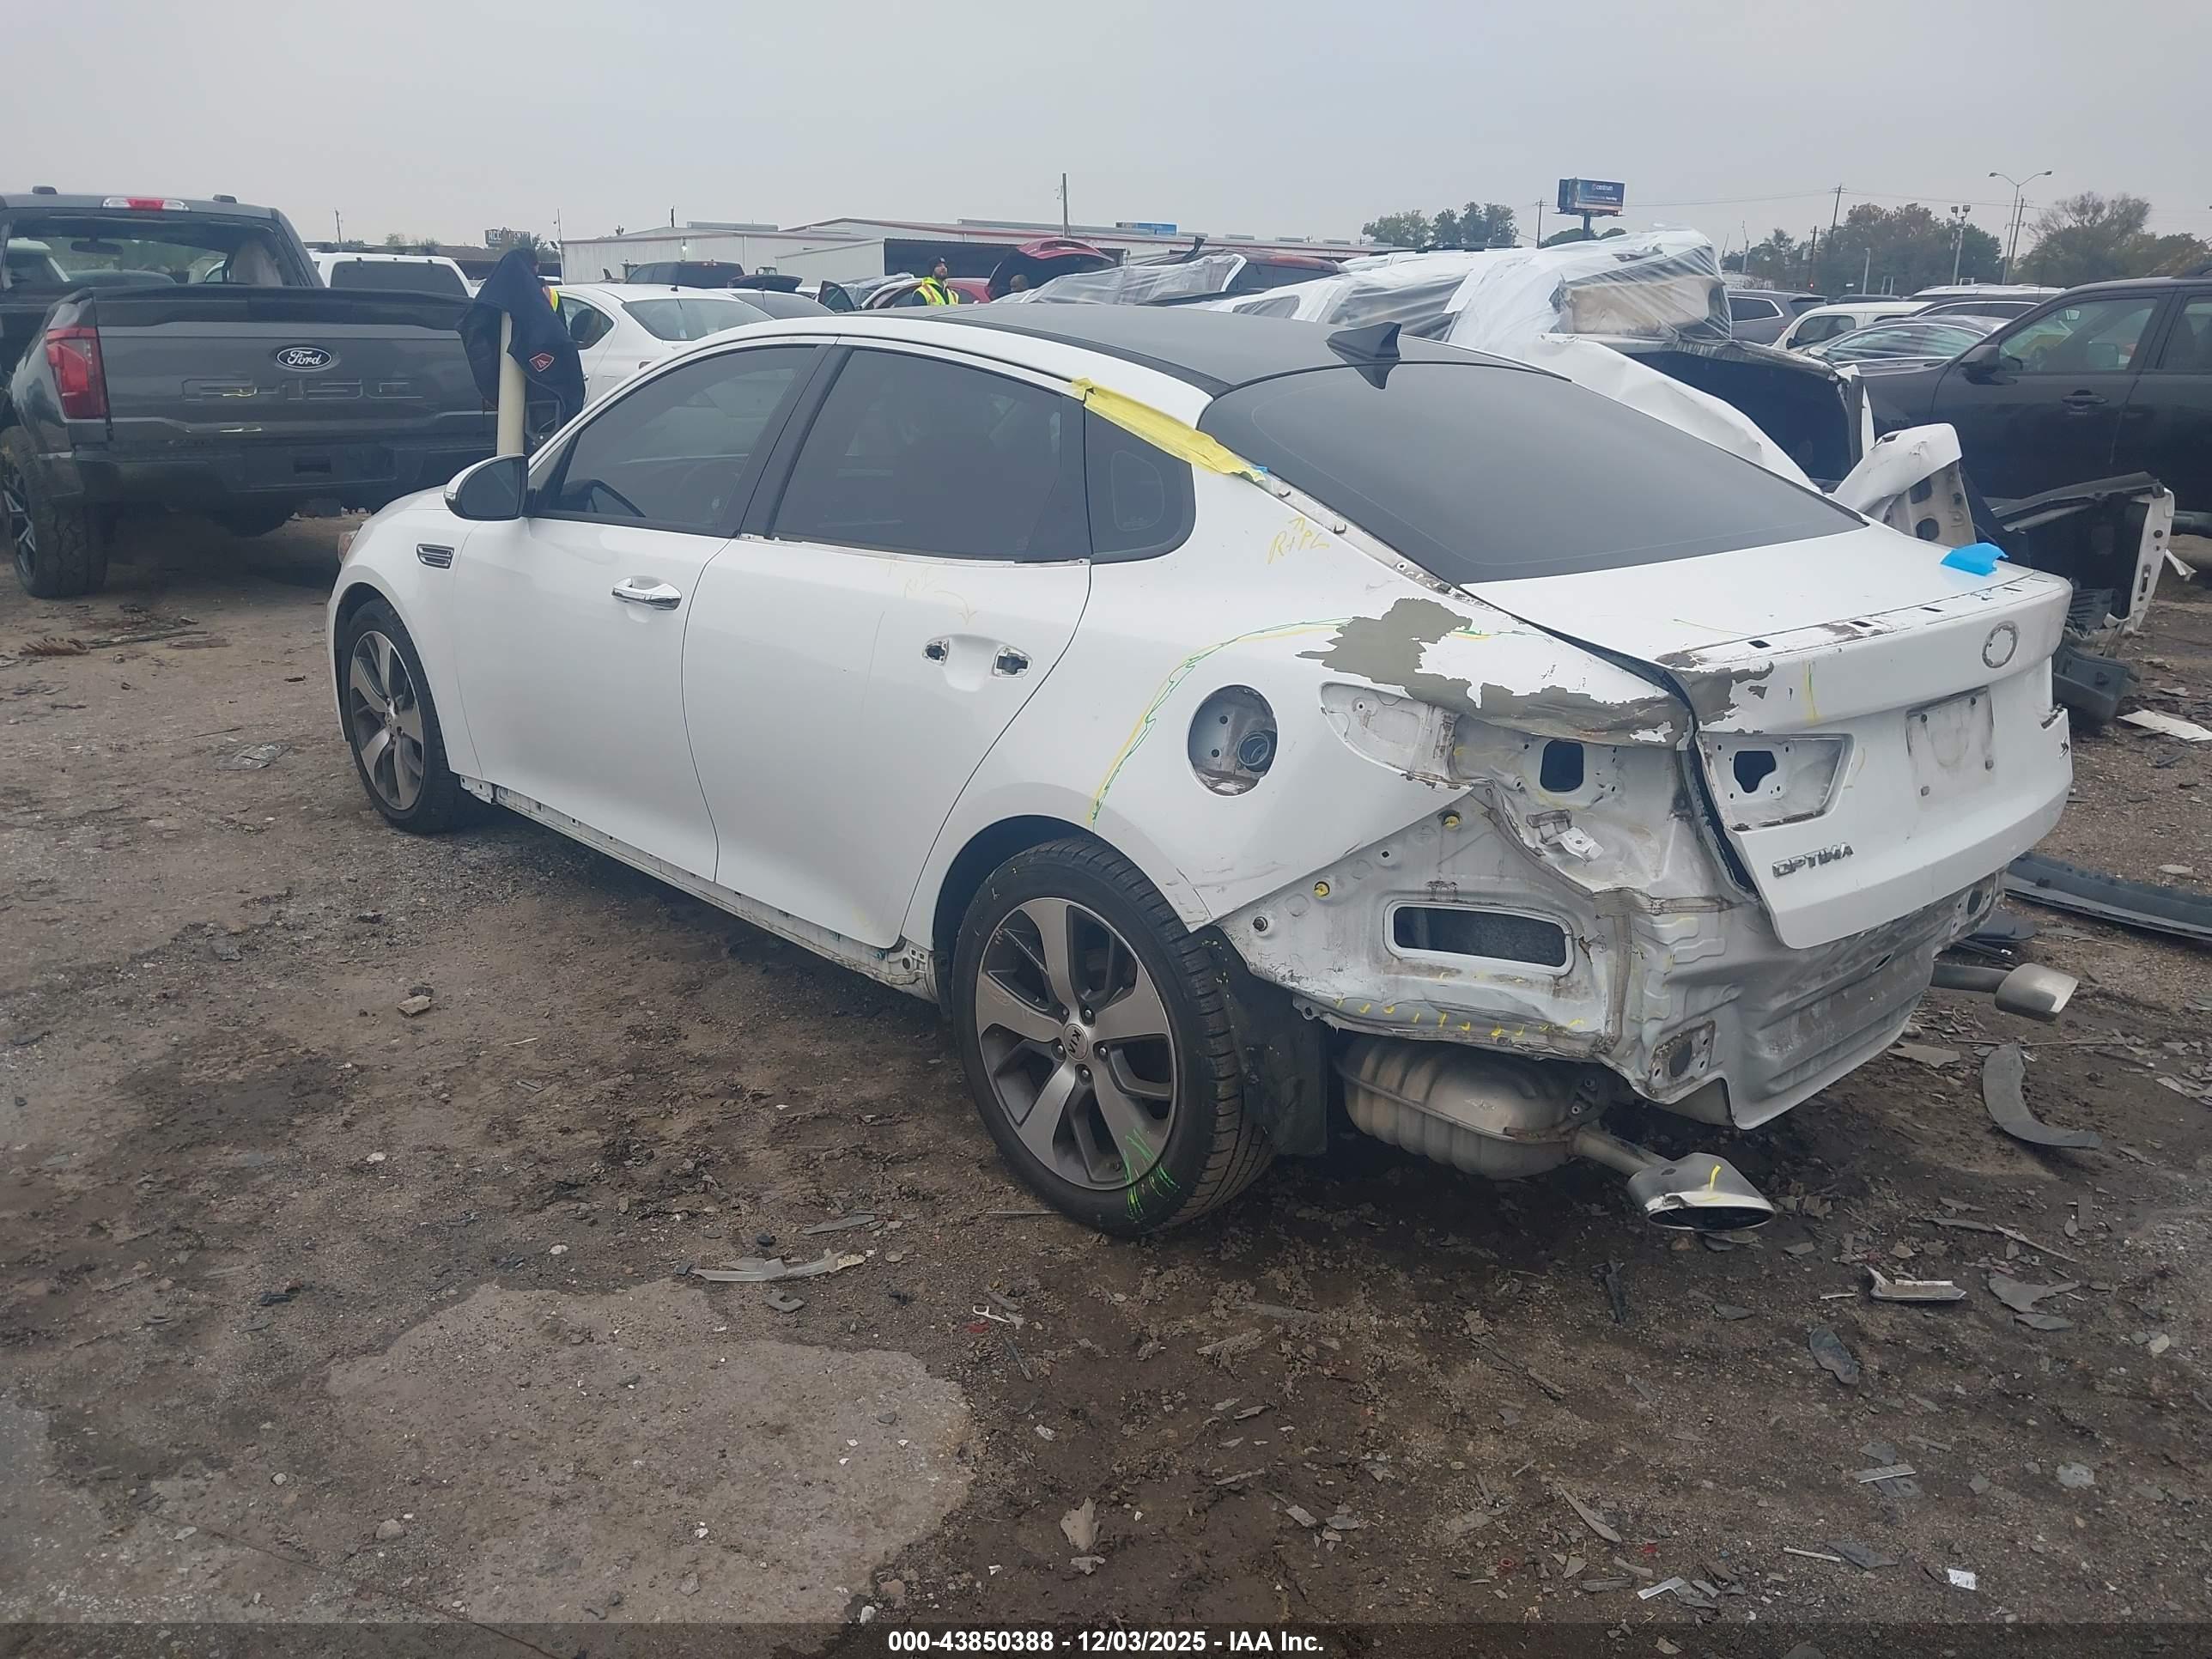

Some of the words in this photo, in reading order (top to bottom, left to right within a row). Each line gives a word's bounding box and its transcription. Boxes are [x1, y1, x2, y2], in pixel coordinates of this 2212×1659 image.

[286, 349, 322, 366] Ford
[1771, 842, 1855, 878] OPTIMA
[1067, 1030, 1081, 1054] KIA
